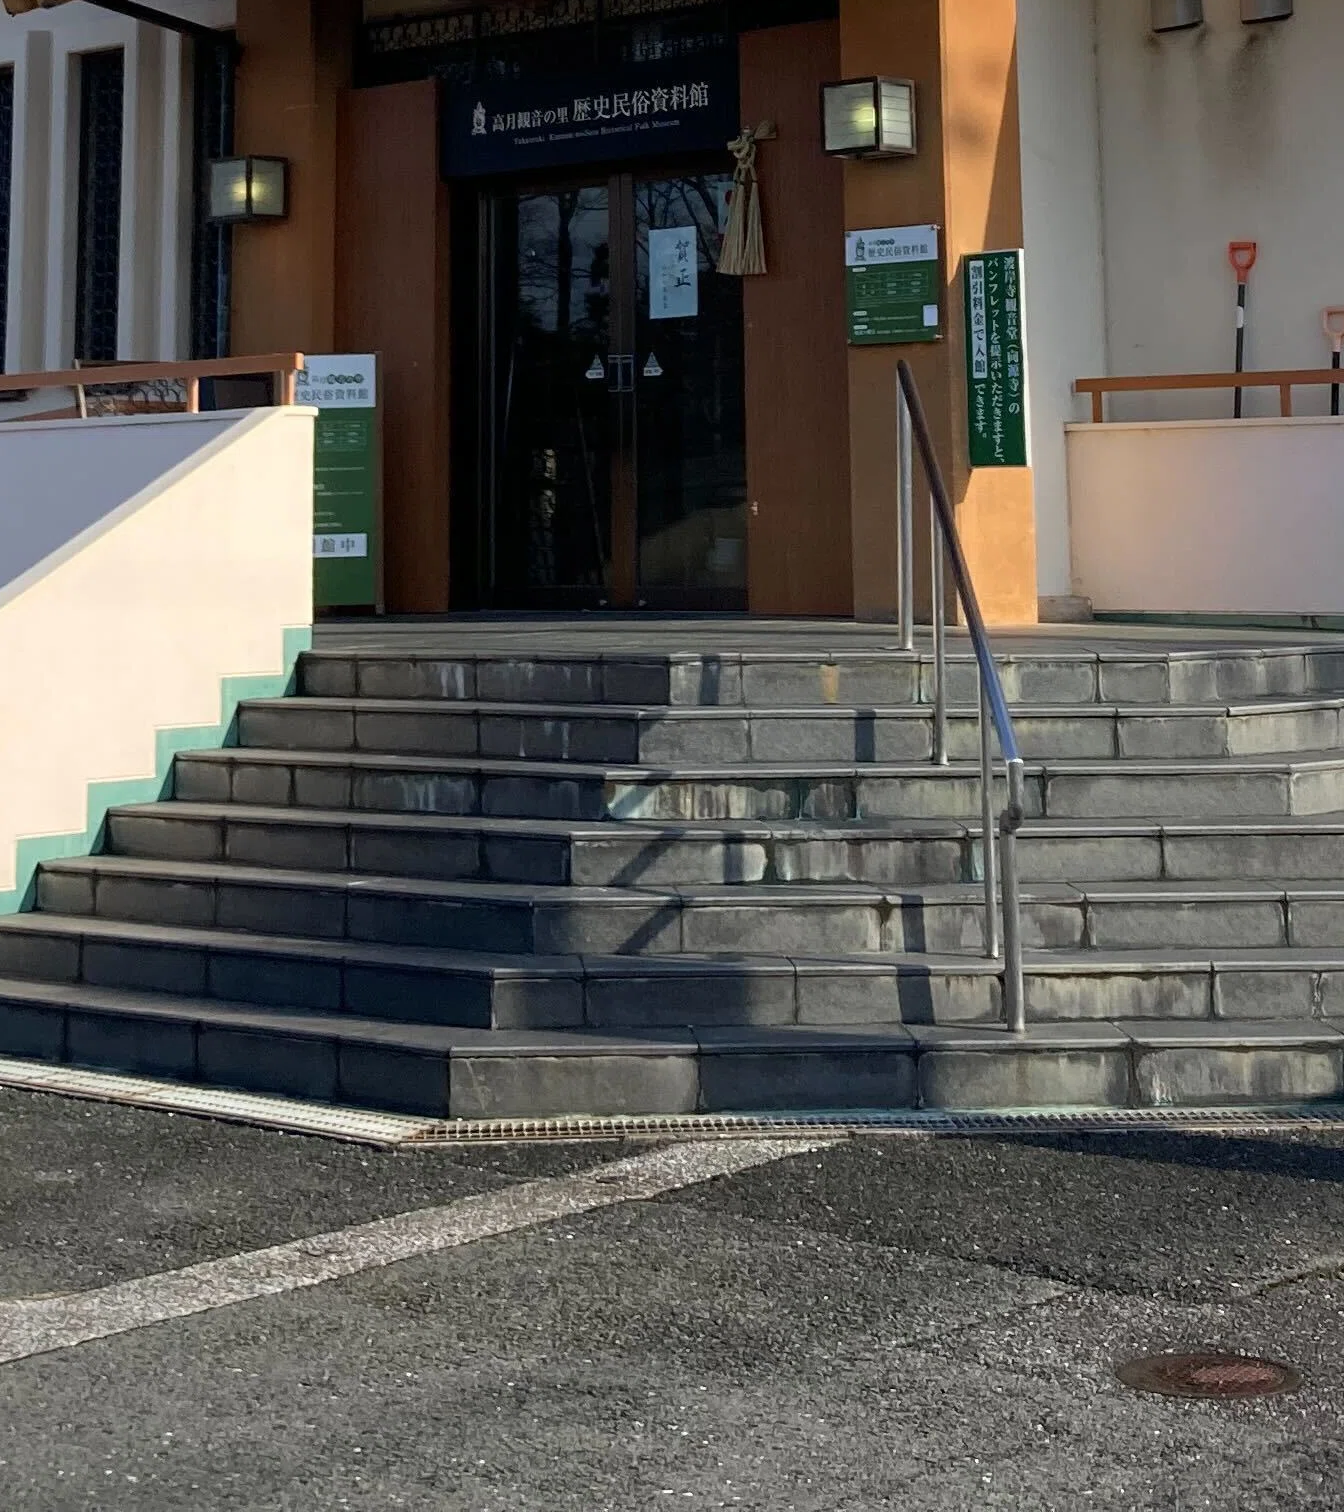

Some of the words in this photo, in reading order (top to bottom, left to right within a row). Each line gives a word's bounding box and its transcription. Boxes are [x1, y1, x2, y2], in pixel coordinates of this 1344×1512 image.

[491, 106, 570, 133] 高月観音の里
[572, 81, 710, 123] 歴史民俗資料館
[296, 388, 369, 402] 史民俗資料館
